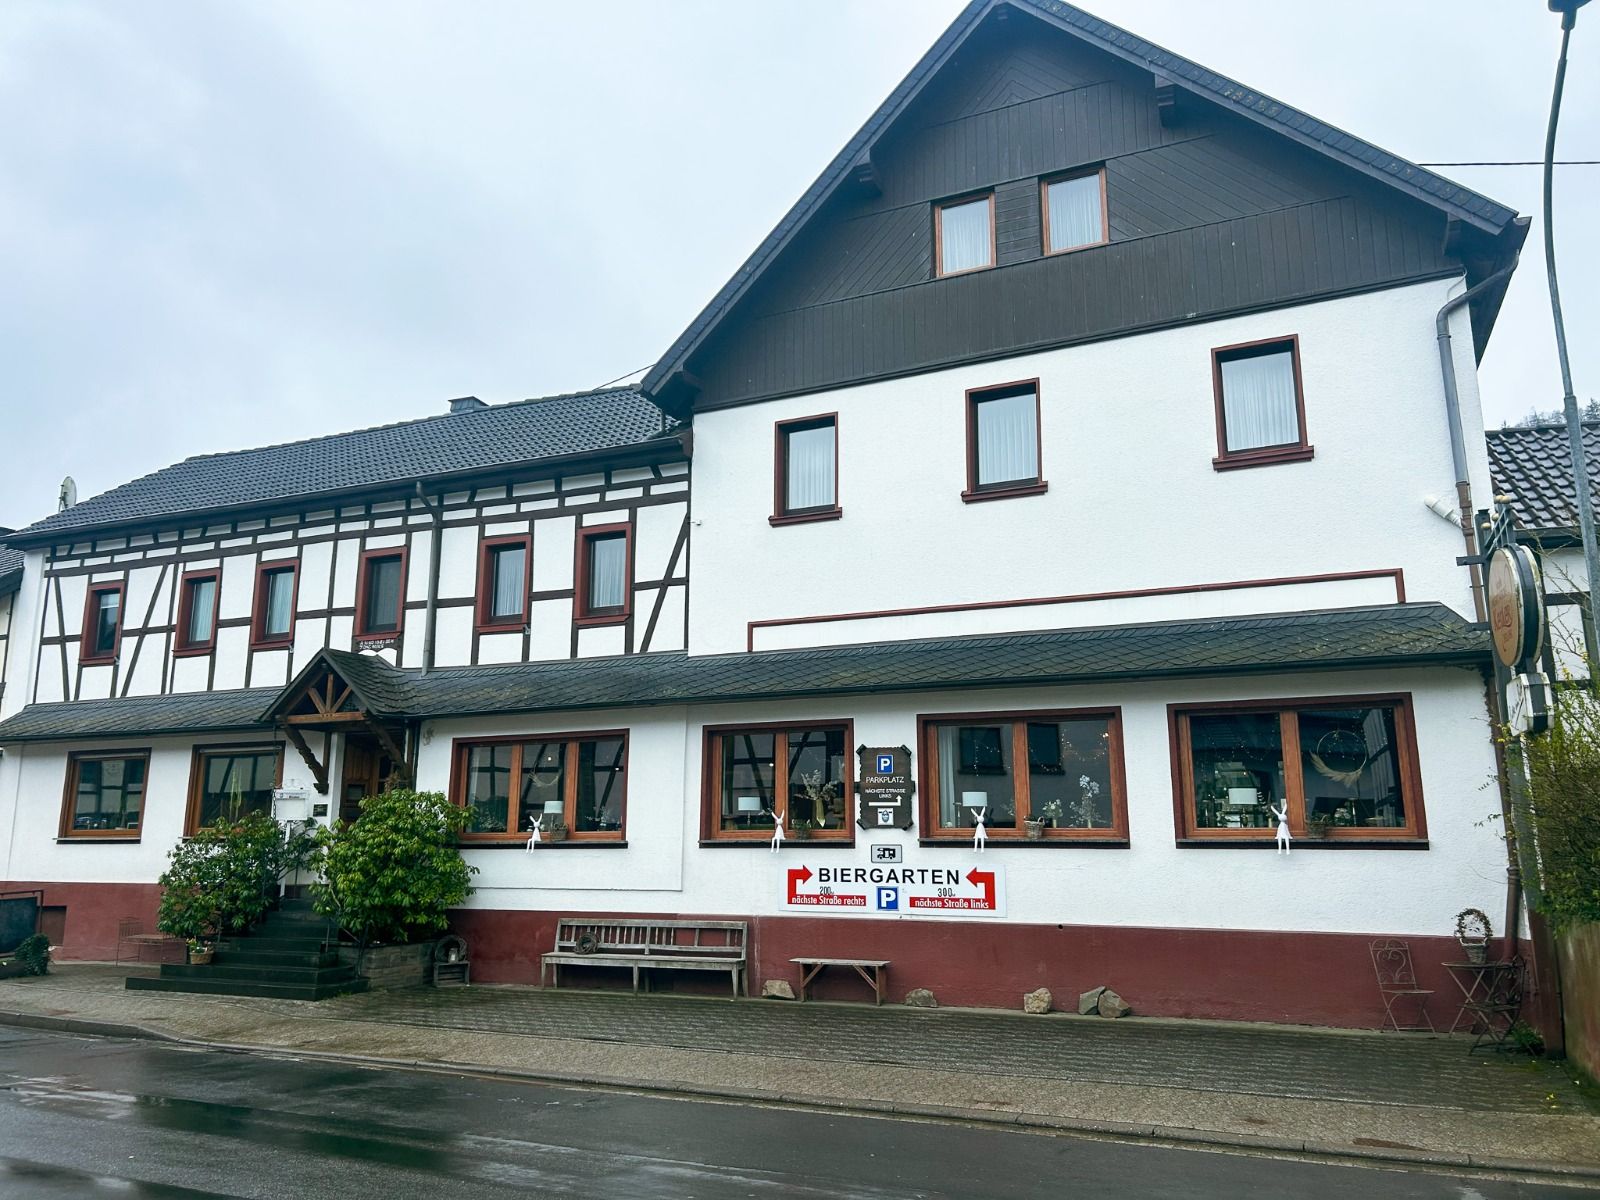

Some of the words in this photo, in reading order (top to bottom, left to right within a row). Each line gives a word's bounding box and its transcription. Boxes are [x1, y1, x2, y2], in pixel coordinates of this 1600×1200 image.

[880, 758, 890, 771] P
[818, 867, 960, 885] BIERGARTEN
[791, 896, 818, 904] nächste
[819, 896, 842, 905] Straße
[843, 896, 865, 906] rechts
[880, 889, 896, 908] P
[914, 898, 942, 907] nächste
[944, 898, 969, 908] Straße
[970, 899, 989, 909] links
